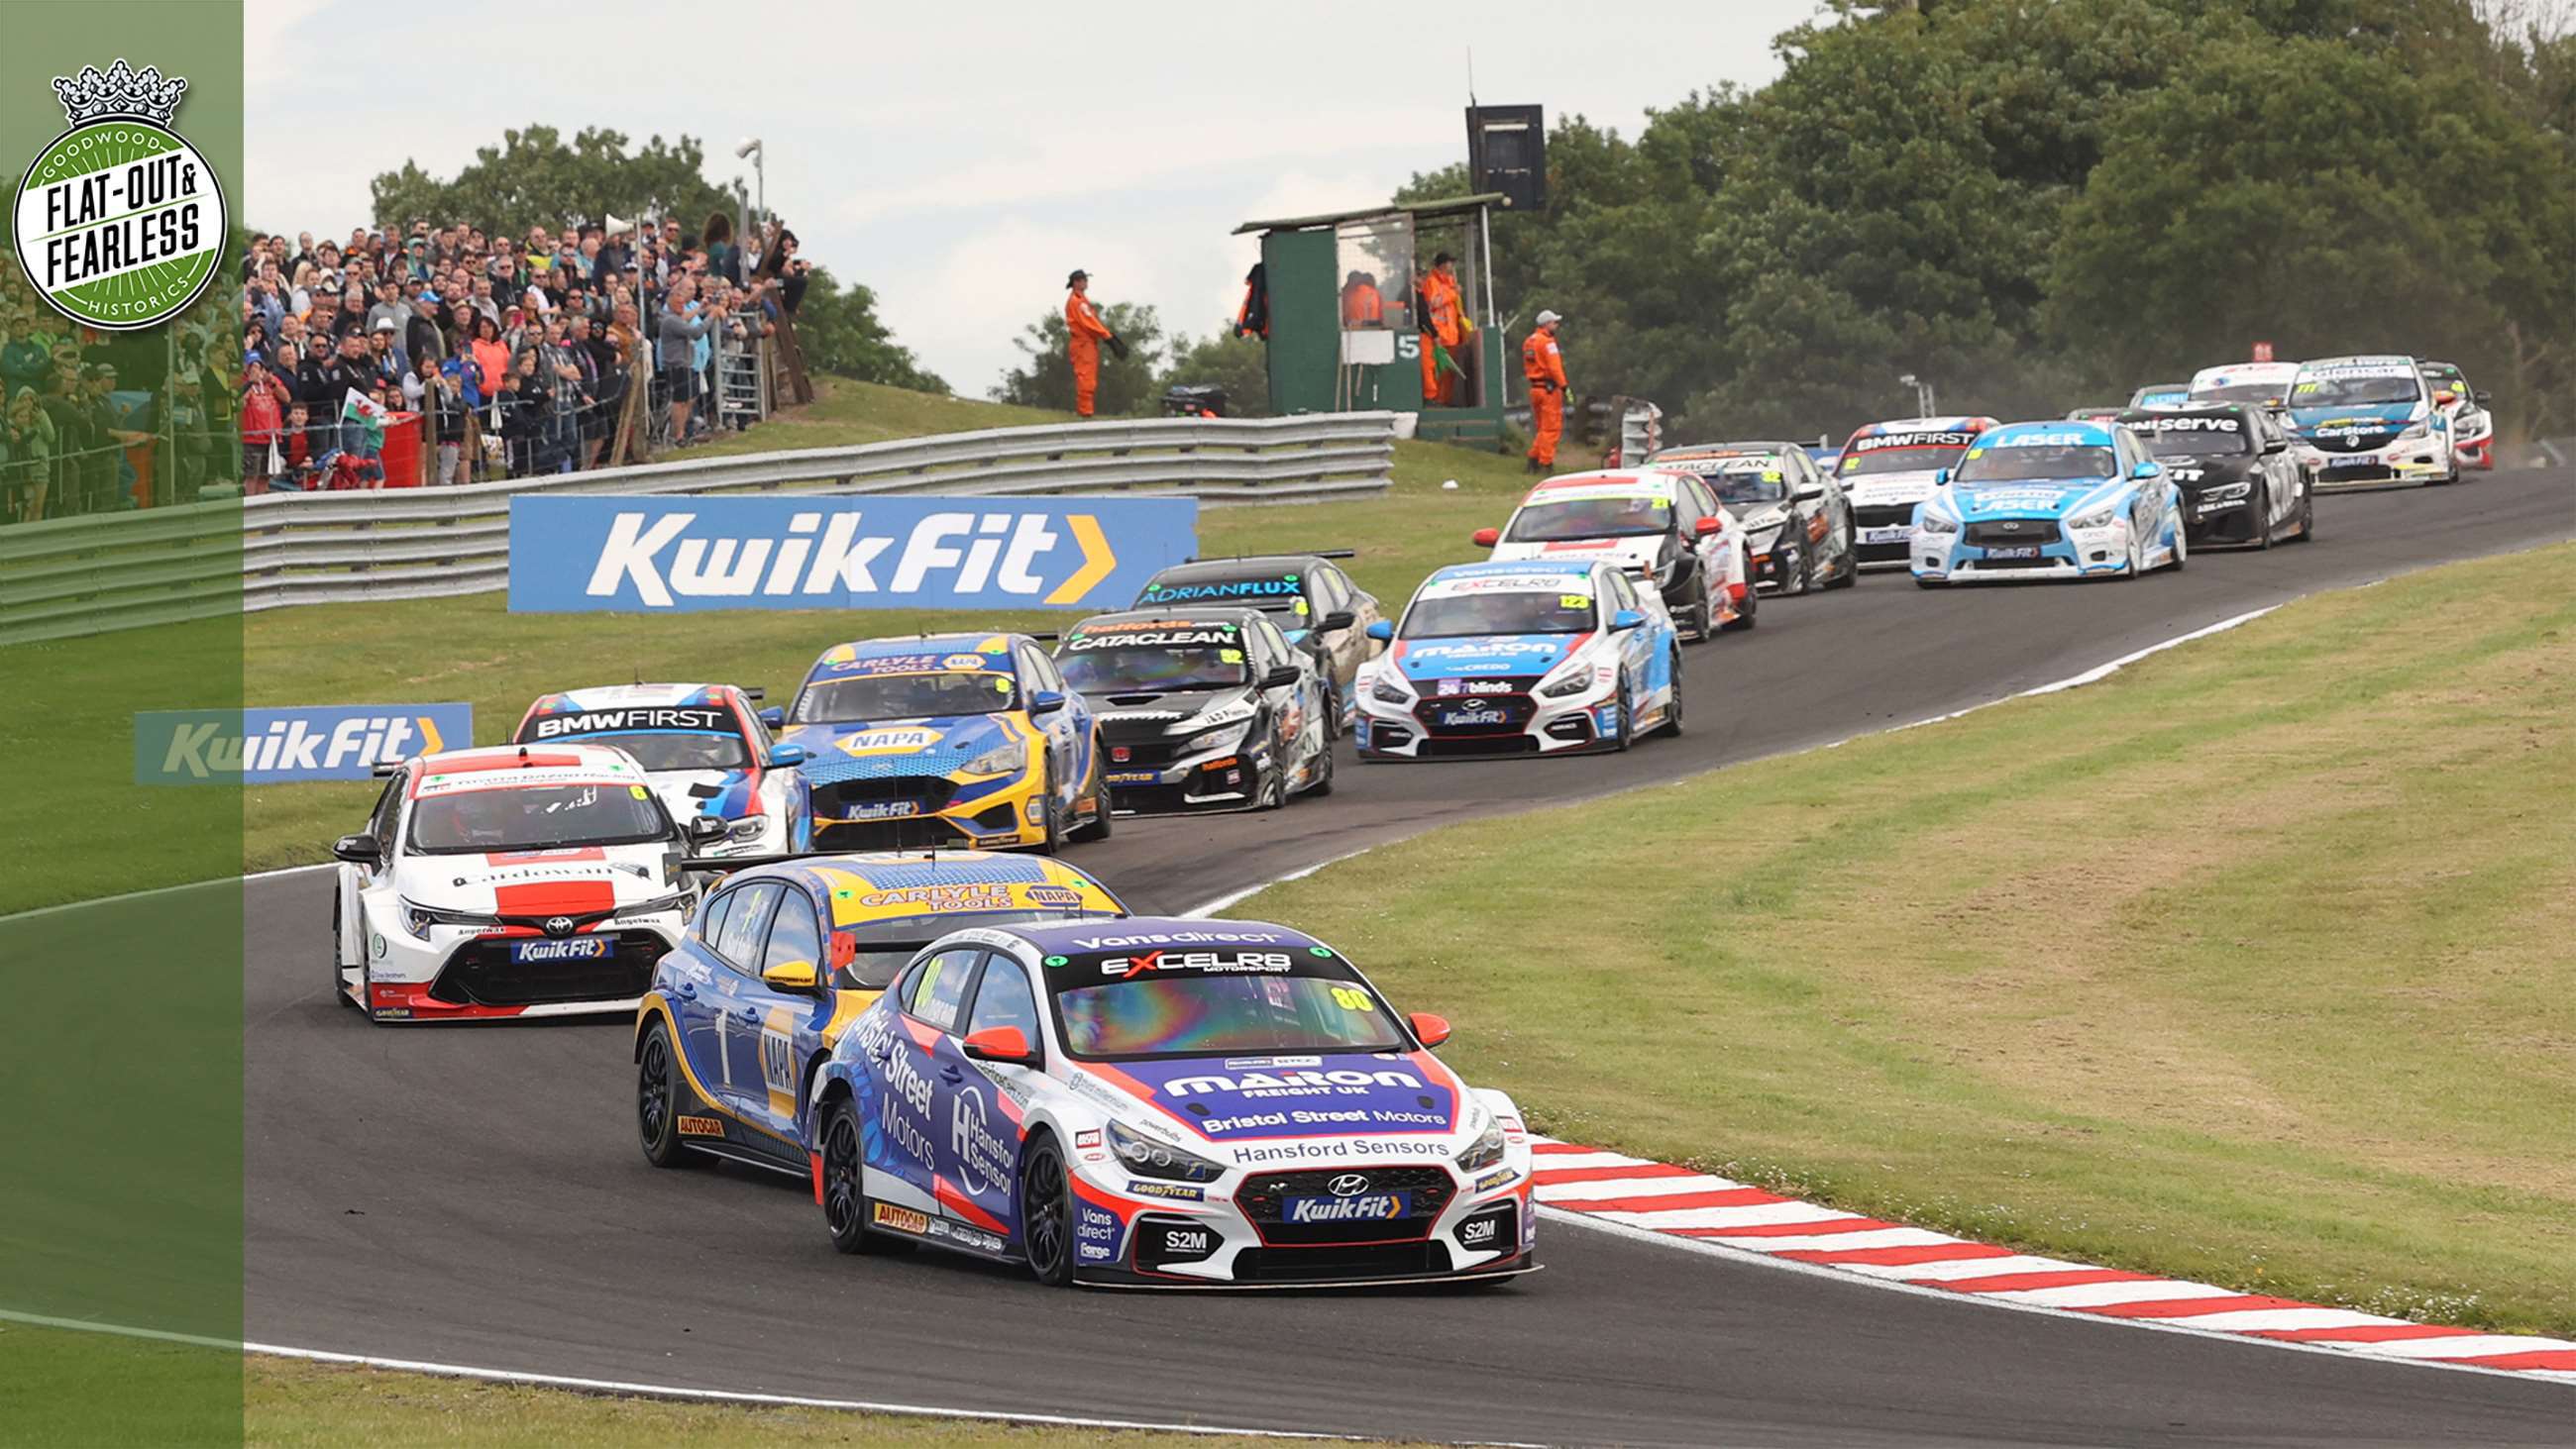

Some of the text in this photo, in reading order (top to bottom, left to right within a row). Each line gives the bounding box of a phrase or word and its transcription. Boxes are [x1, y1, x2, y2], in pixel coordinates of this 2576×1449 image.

[1398, 335, 1420, 359] 5
[1994, 433, 2086, 447] LASER
[1069, 632, 1236, 651] CATACLEAN
[830, 655, 936, 672] CARLYLE
[872, 665, 931, 674] TOOLS
[852, 732, 924, 748] NAPA
[860, 884, 1011, 906] CARLYLE
[927, 897, 1015, 911] TOOLS
[1032, 888, 1080, 903] NAPA
[1101, 950, 1292, 979] EXCELR8
[1331, 987, 1373, 1011] 80
[885, 1038, 934, 1121] Street
[1242, 1086, 1370, 1099] FREIGHT UK
[680, 1116, 724, 1135] AUTOCAR
[1202, 1109, 1448, 1134] Bristol Street Motors
[882, 1092, 936, 1172] Motors
[1234, 1138, 1450, 1164] Hansford Sensors
[1132, 1183, 1198, 1198] GOODYEAR
[1081, 1207, 1113, 1226] Vans
[1077, 1224, 1114, 1241] direct
[1463, 1219, 1496, 1240] S2M
[1165, 1230, 1208, 1250] S2M
